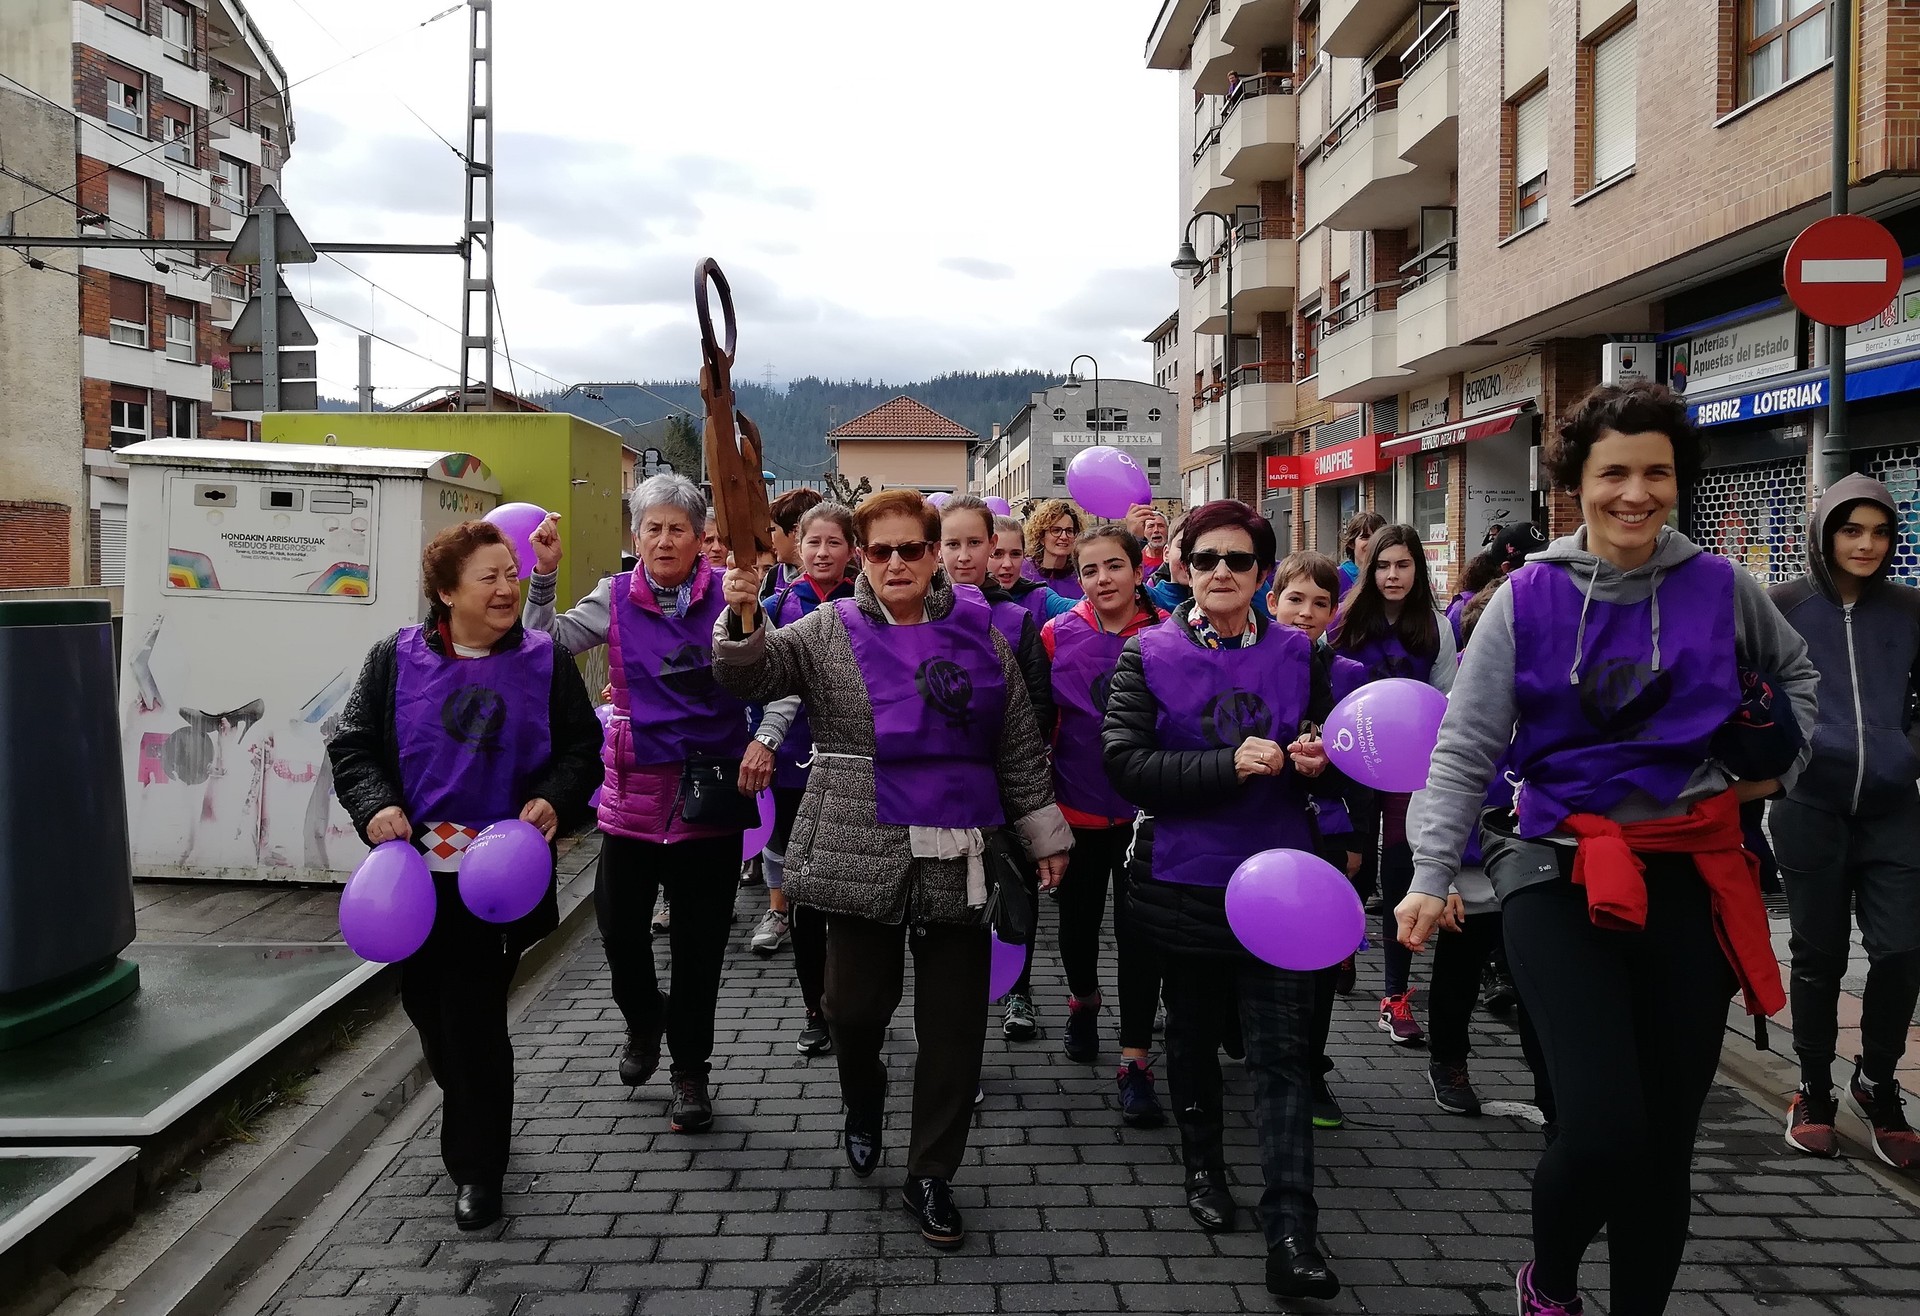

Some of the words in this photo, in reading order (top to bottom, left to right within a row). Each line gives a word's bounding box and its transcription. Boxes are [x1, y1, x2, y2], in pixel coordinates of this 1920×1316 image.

[1693, 335, 1729, 356] Loterías
[1732, 333, 1738, 349] y
[1693, 353, 1734, 377] Apuestas
[1736, 344, 1751, 363] del
[1754, 335, 1789, 359] Estado
[1466, 373, 1501, 406] BERRIZKO
[1698, 398, 1741, 424] BERRIZ
[1753, 382, 1822, 415] LOTERIAK
[1063, 435, 1107, 443] KULTUR
[1117, 435, 1153, 443] ETXEA
[1319, 449, 1353, 475] MAPFRE
[1429, 473, 1439, 486] EAT
[221, 533, 264, 542] HONDAKIN
[266, 535, 325, 545] ARRISKUTSUAK
[228, 541, 267, 550] RESIDUOS
[269, 542, 317, 552] PELIGROSOS
